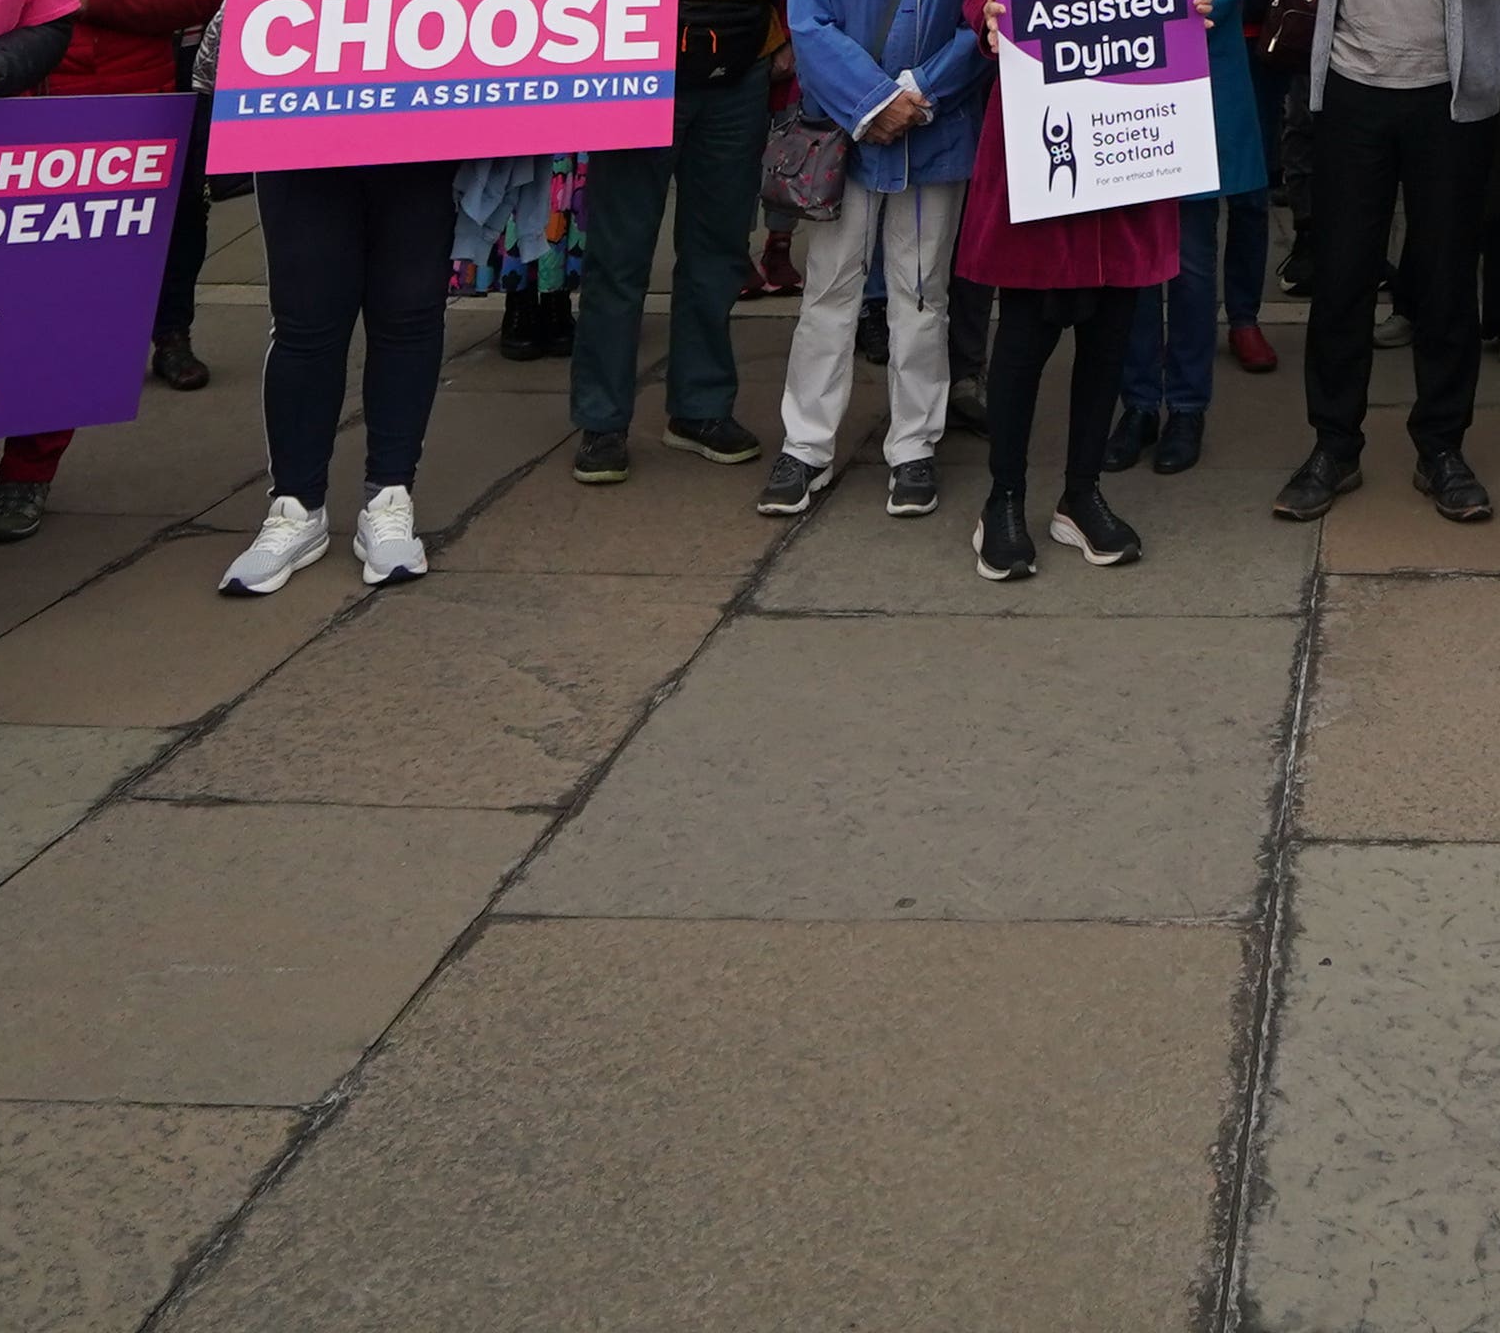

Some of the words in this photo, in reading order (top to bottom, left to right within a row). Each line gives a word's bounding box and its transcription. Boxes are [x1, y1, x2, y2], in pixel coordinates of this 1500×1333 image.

[1054, 33, 1157, 82] Dying
[238, 87, 397, 115] LEGALISE
[411, 78, 560, 108] ASSISTED
[572, 74, 660, 99] DYING
[1091, 101, 1177, 127] Humanist
[1092, 126, 1160, 149] Society
[1094, 141, 1175, 167] Scotland
